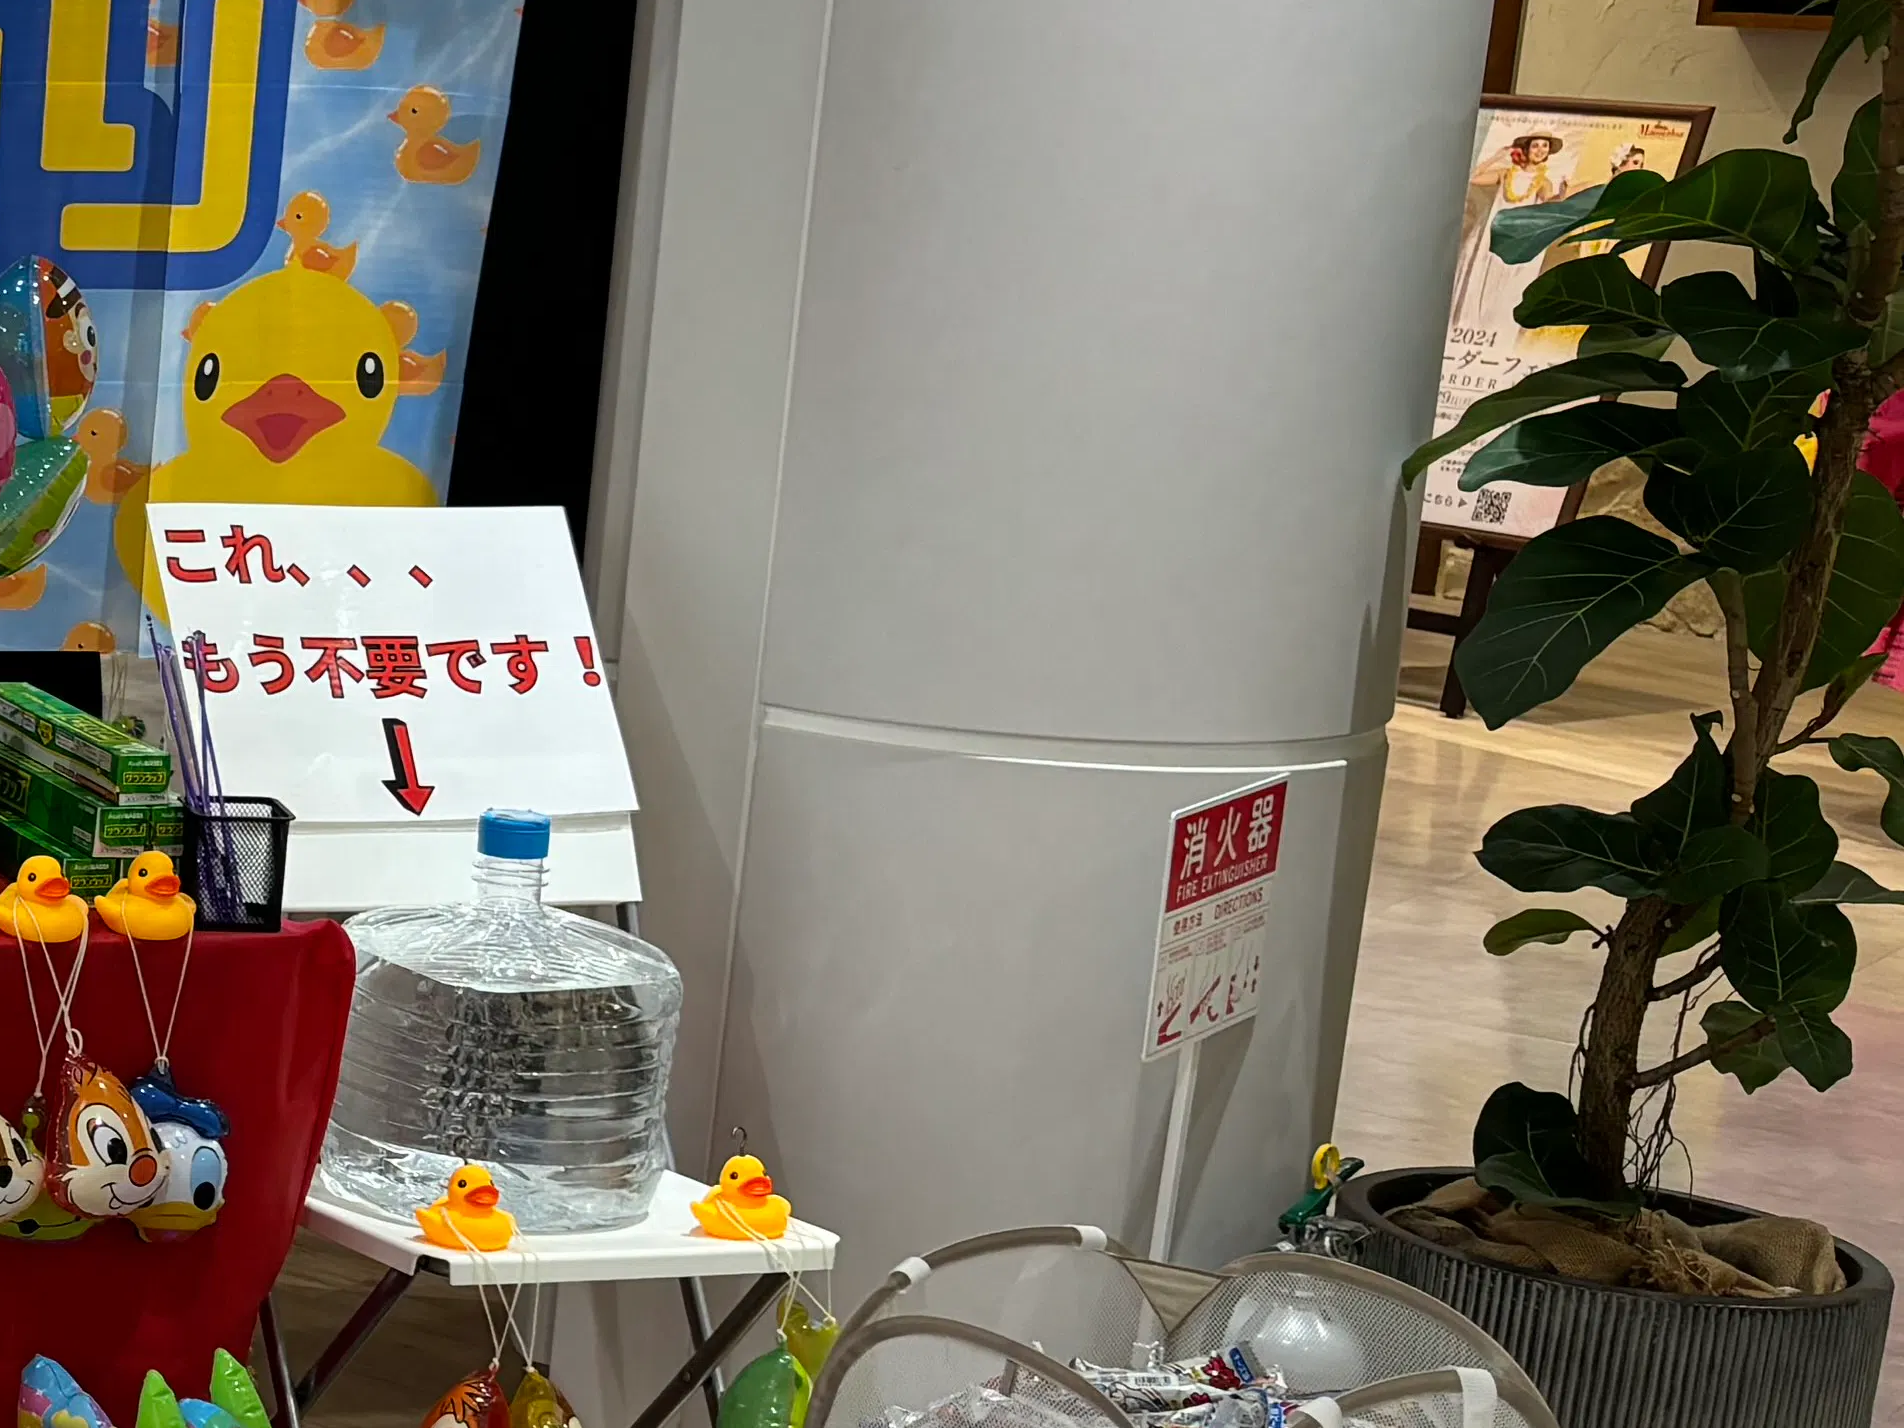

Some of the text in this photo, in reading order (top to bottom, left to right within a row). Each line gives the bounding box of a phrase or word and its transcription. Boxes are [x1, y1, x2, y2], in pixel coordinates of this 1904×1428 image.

[1450, 327, 1498, 348] 2024
[1441, 373, 1497, 390] RDER
[181, 635, 602, 699] もう不要です！
[1180, 793, 1275, 881] 消火器
[1176, 853, 1269, 903] FIRE EXTINGUISHER
[1214, 887, 1264, 920] DIRECTIONS
